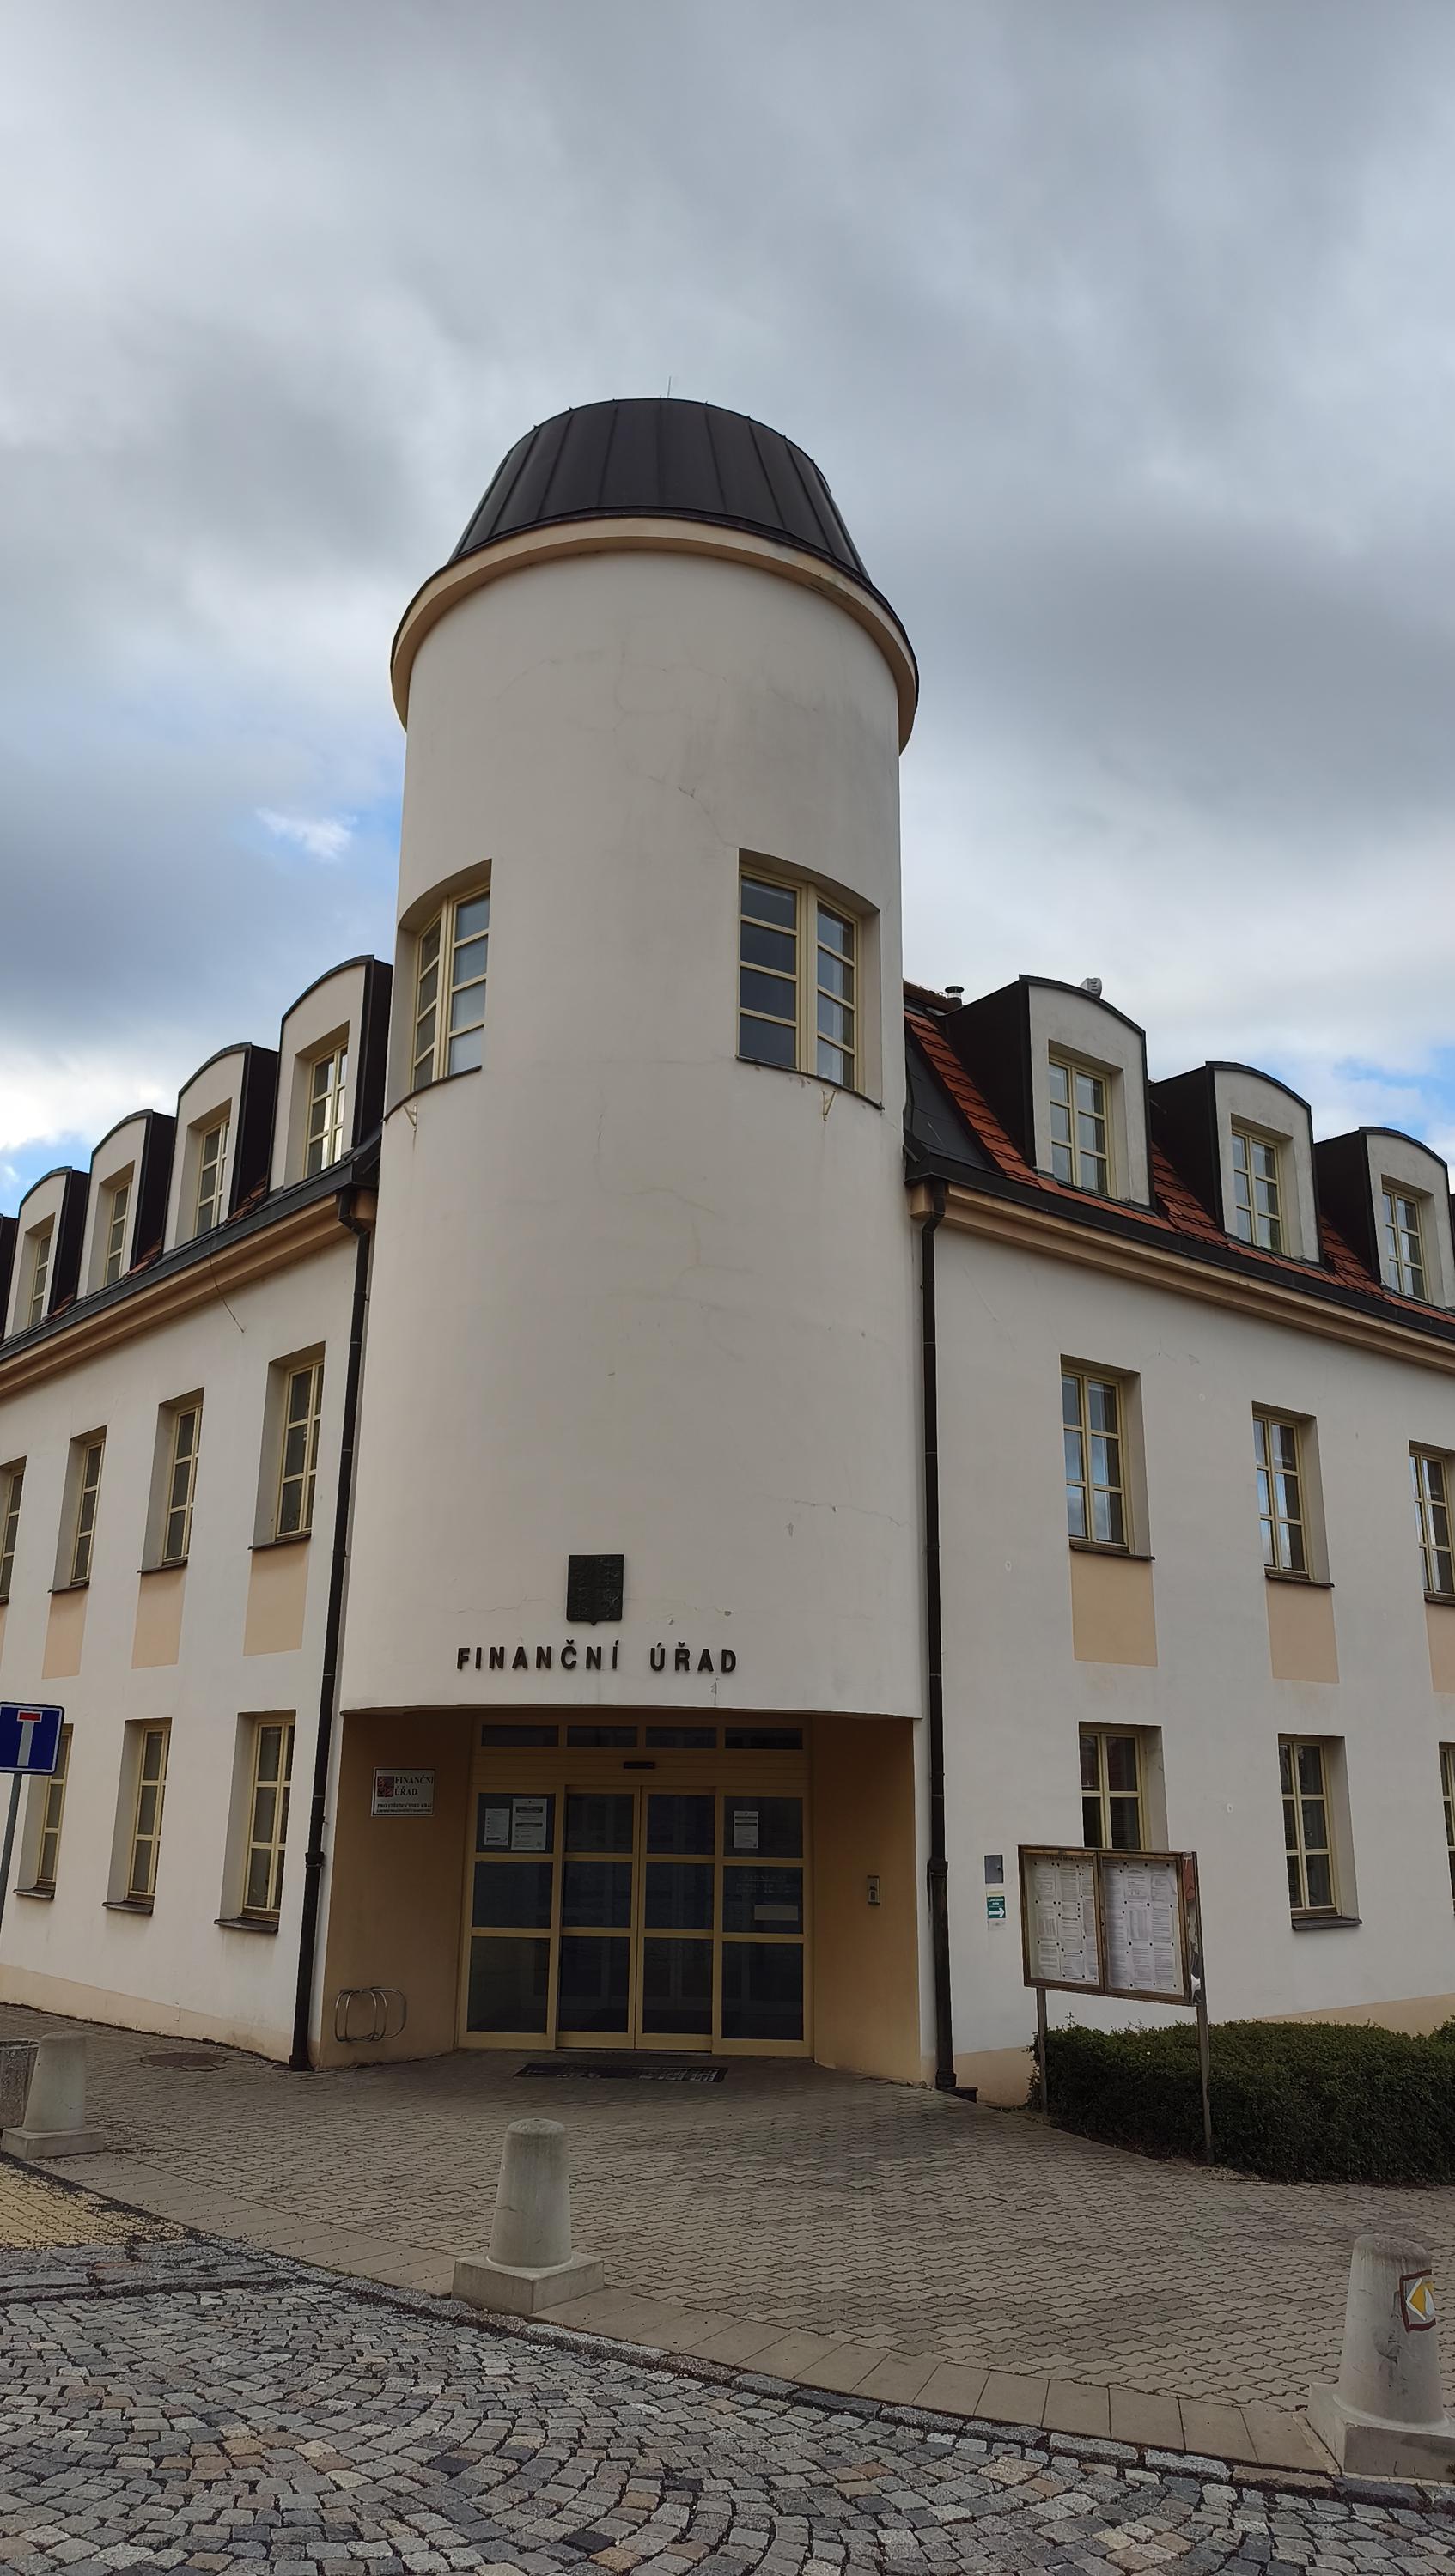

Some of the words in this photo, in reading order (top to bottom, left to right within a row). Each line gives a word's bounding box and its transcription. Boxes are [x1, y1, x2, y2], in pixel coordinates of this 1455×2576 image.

[456, 1639, 620, 1670] FINANČNÍ
[649, 1642, 737, 1673] ÚŘAD
[394, 1786, 417, 1795] ÚŘAD
